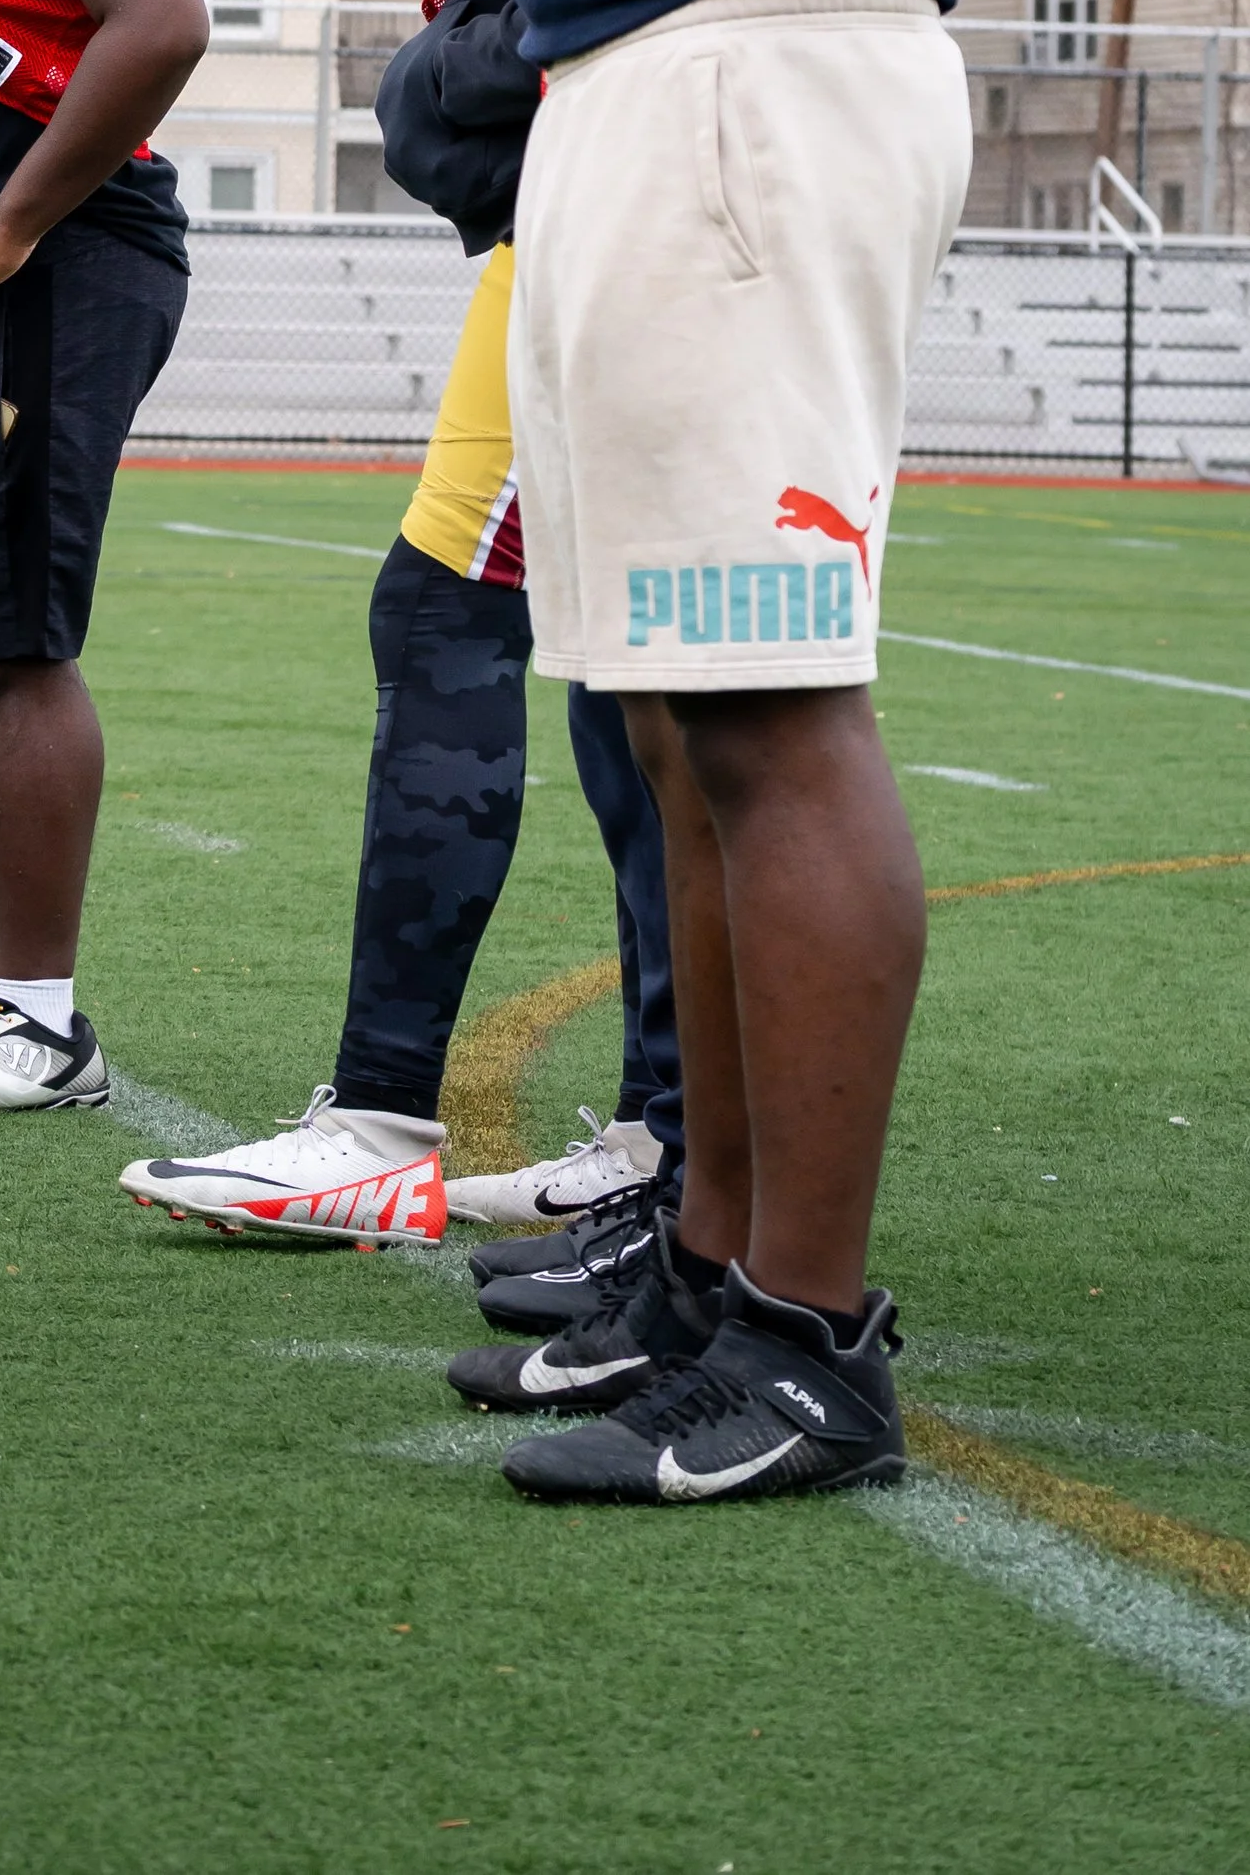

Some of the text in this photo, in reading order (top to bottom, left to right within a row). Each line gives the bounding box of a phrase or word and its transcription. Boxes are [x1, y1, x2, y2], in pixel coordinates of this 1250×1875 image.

[627, 562, 854, 646] PUMA
[278, 1161, 435, 1236] NIKE
[774, 1380, 826, 1424] ALPHA
